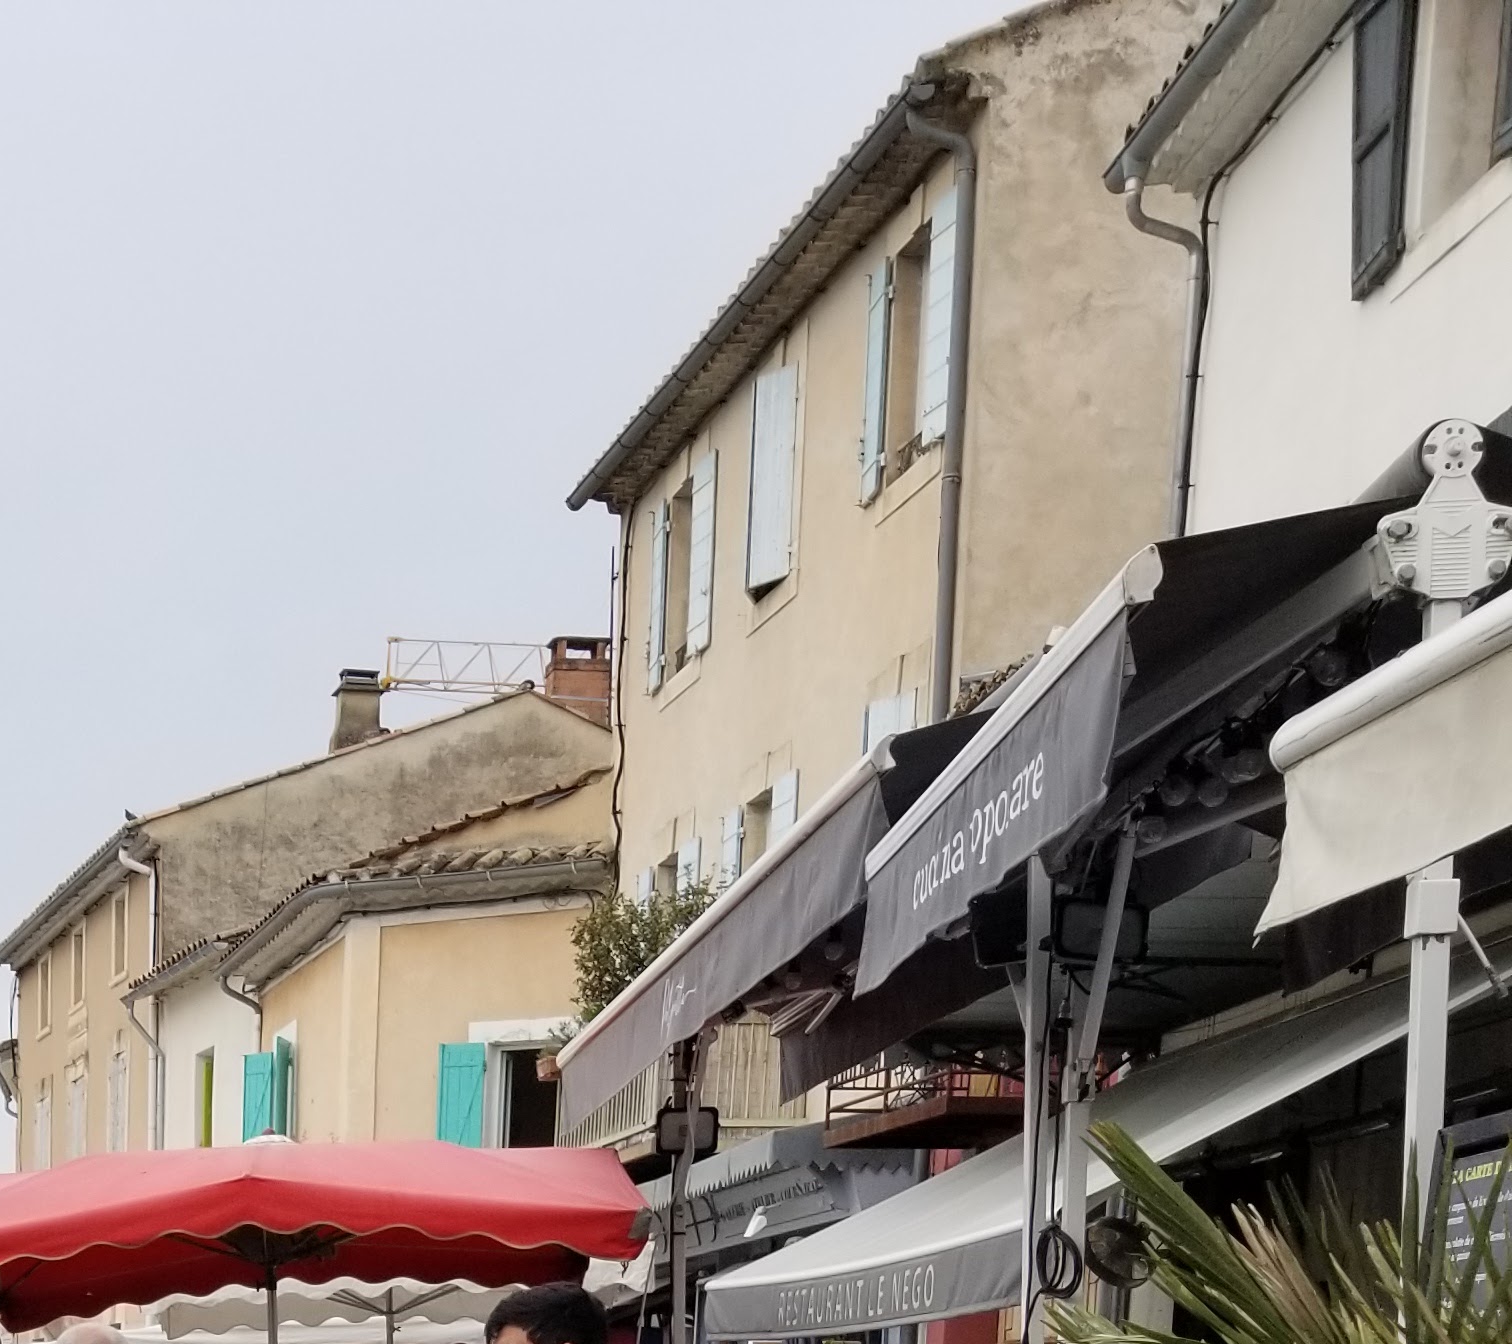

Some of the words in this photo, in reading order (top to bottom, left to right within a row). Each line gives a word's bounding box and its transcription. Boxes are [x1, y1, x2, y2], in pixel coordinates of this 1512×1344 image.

[778, 1279, 864, 1327] RESTAURANT
[867, 1275, 885, 1317] LE
[891, 1264, 935, 1313] NEGO
